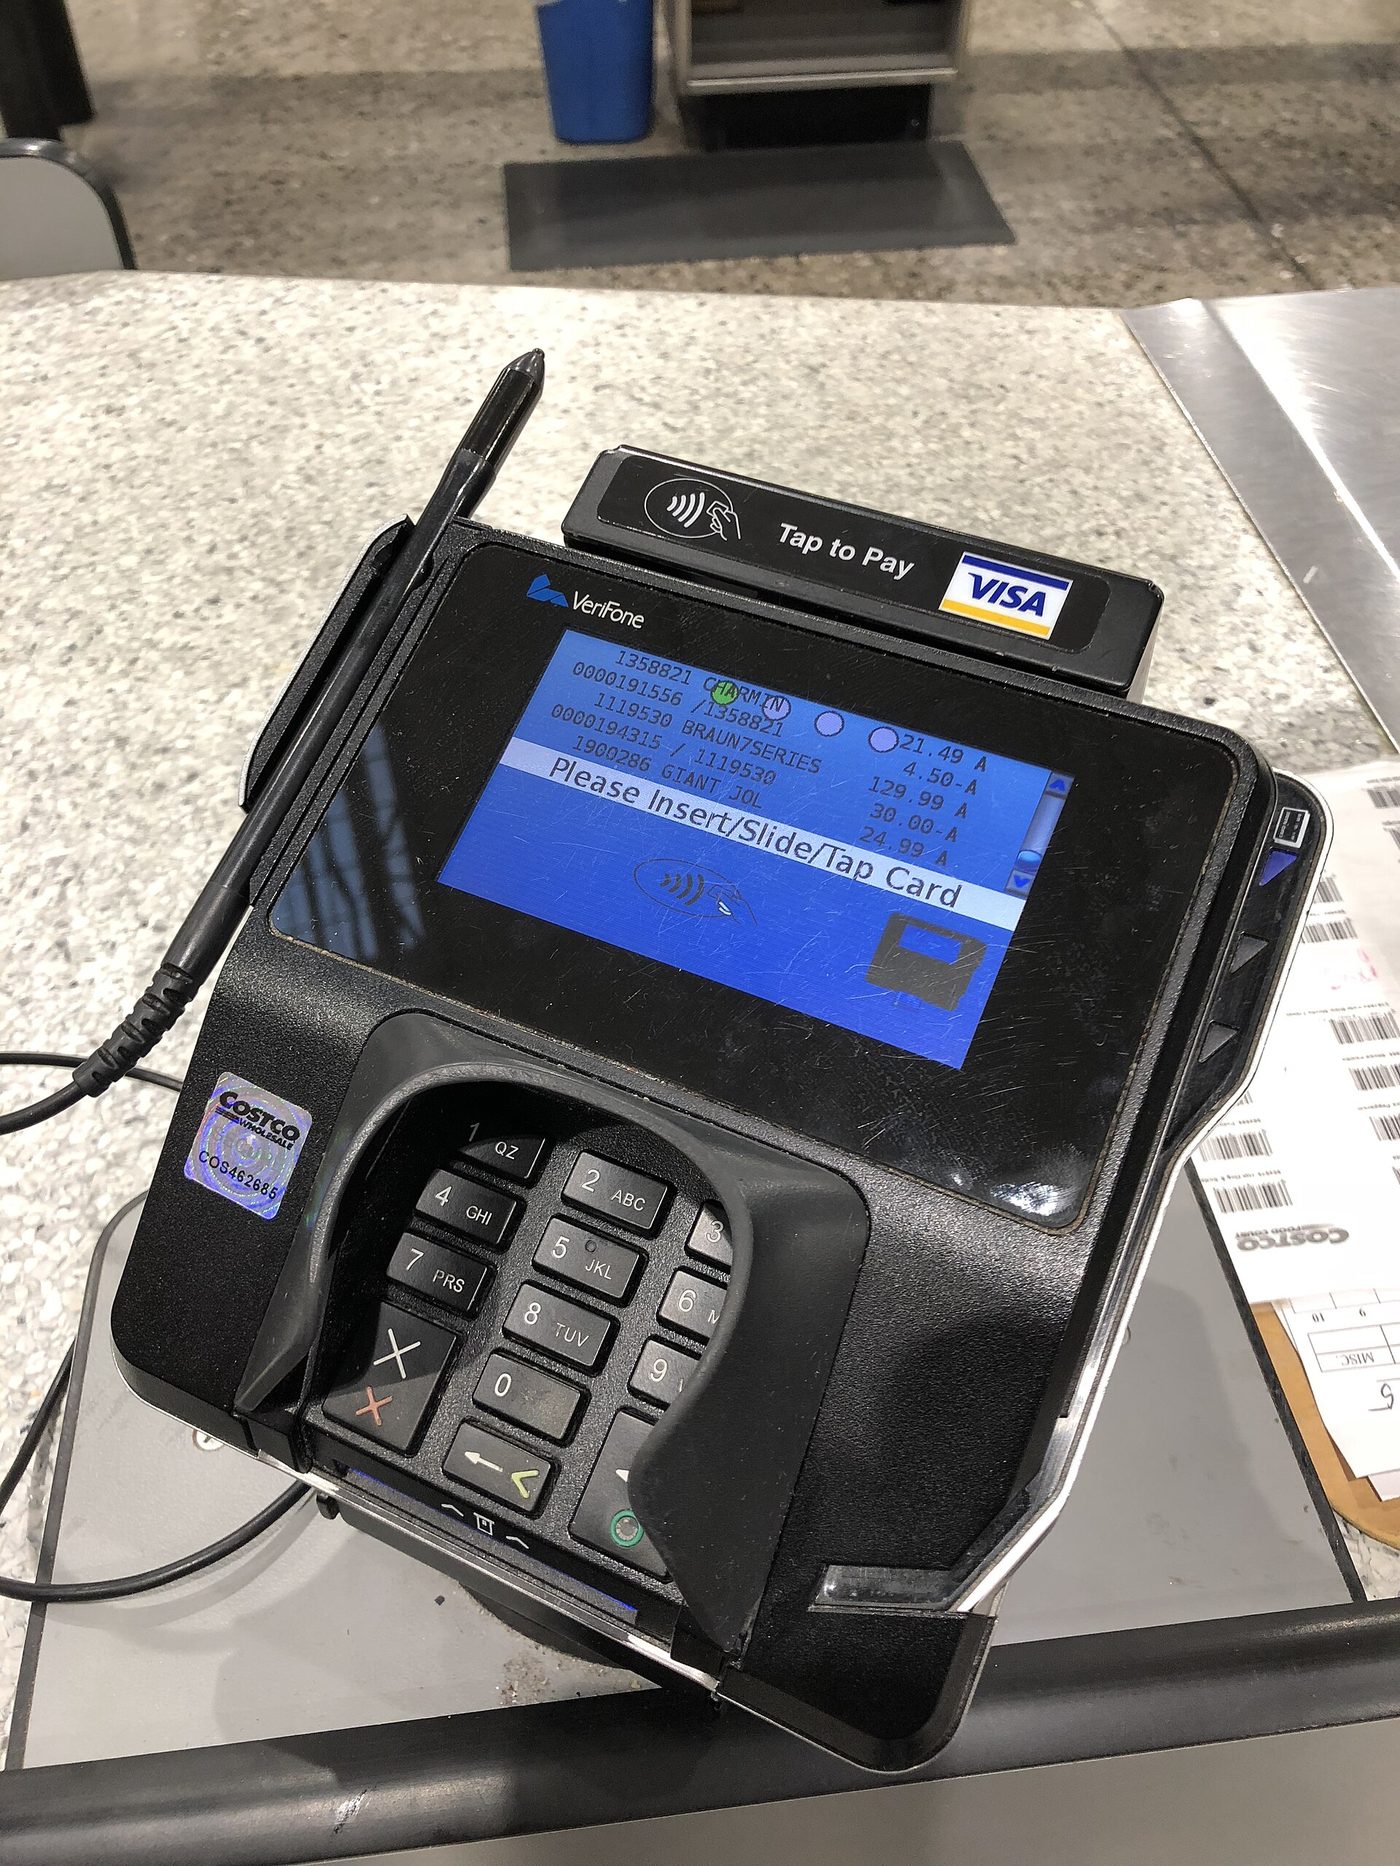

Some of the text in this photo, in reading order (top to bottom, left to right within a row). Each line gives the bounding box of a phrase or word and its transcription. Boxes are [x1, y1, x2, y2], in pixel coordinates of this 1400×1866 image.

[778, 522, 916, 581] Tap to Pay
[572, 590, 645, 629] VeriFone
[967, 571, 1047, 617] VISA
[572, 661, 684, 706] 0000191556
[615, 650, 987, 772] 1358821 CHARMIN 21.49 A
[550, 703, 663, 750] 0000194315
[694, 748, 777, 786] 1119530
[593, 691, 968, 819] 1119530 BRAUN7SERIES 129.99 A
[571, 735, 652, 773] 1900286
[661, 764, 722, 794] GIANT
[858, 826, 925, 858] 24.99
[935, 849, 948, 867] A
[548, 756, 963, 908] Please Insert/Slide/Tap Card
[218, 1091, 301, 1142] COSTCO
[238, 1117, 295, 1151] WHOLESALE
[468, 1122, 519, 1160] 1 QZ
[198, 1150, 279, 1200] COS462685
[581, 1169, 646, 1212] 2 ABC
[434, 1186, 493, 1226] 4 GHI
[705, 1220, 724, 1243] 3
[1236, 1227, 1350, 1252] COSTCO
[405, 1248, 466, 1293] 7 PRS
[551, 1236, 612, 1281] 5 JKL
[678, 1289, 697, 1312] 6
[1311, 1312, 1325, 1323] 10
[523, 1301, 590, 1348] 8 TUV
[650, 1358, 668, 1382] 9
[1335, 1351, 1375, 1366] MISC.
